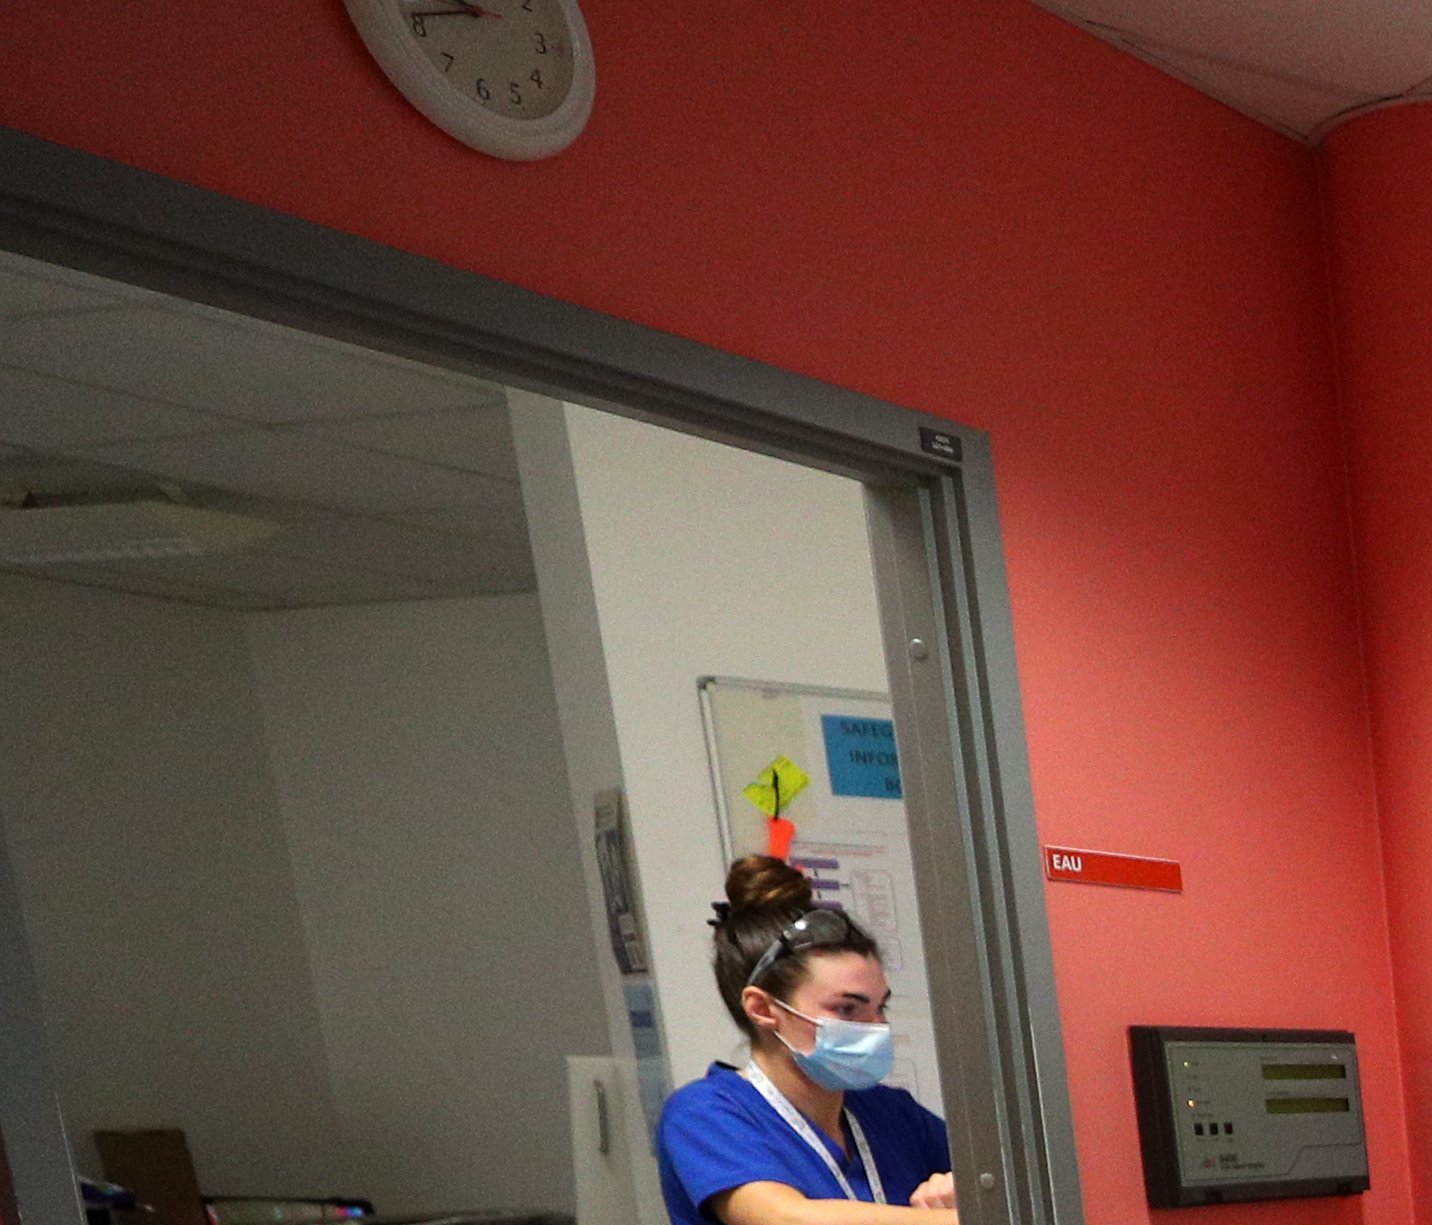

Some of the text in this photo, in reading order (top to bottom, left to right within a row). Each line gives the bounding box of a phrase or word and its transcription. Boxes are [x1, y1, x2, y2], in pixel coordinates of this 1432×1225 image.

[411, 15, 426, 37] 8
[533, 32, 547, 54] 3
[439, 51, 454, 72] 7
[476, 78, 490, 100] 6
[530, 68, 543, 88] 4
[510, 82, 522, 105] 5
[1052, 854, 1082, 871] EAU
